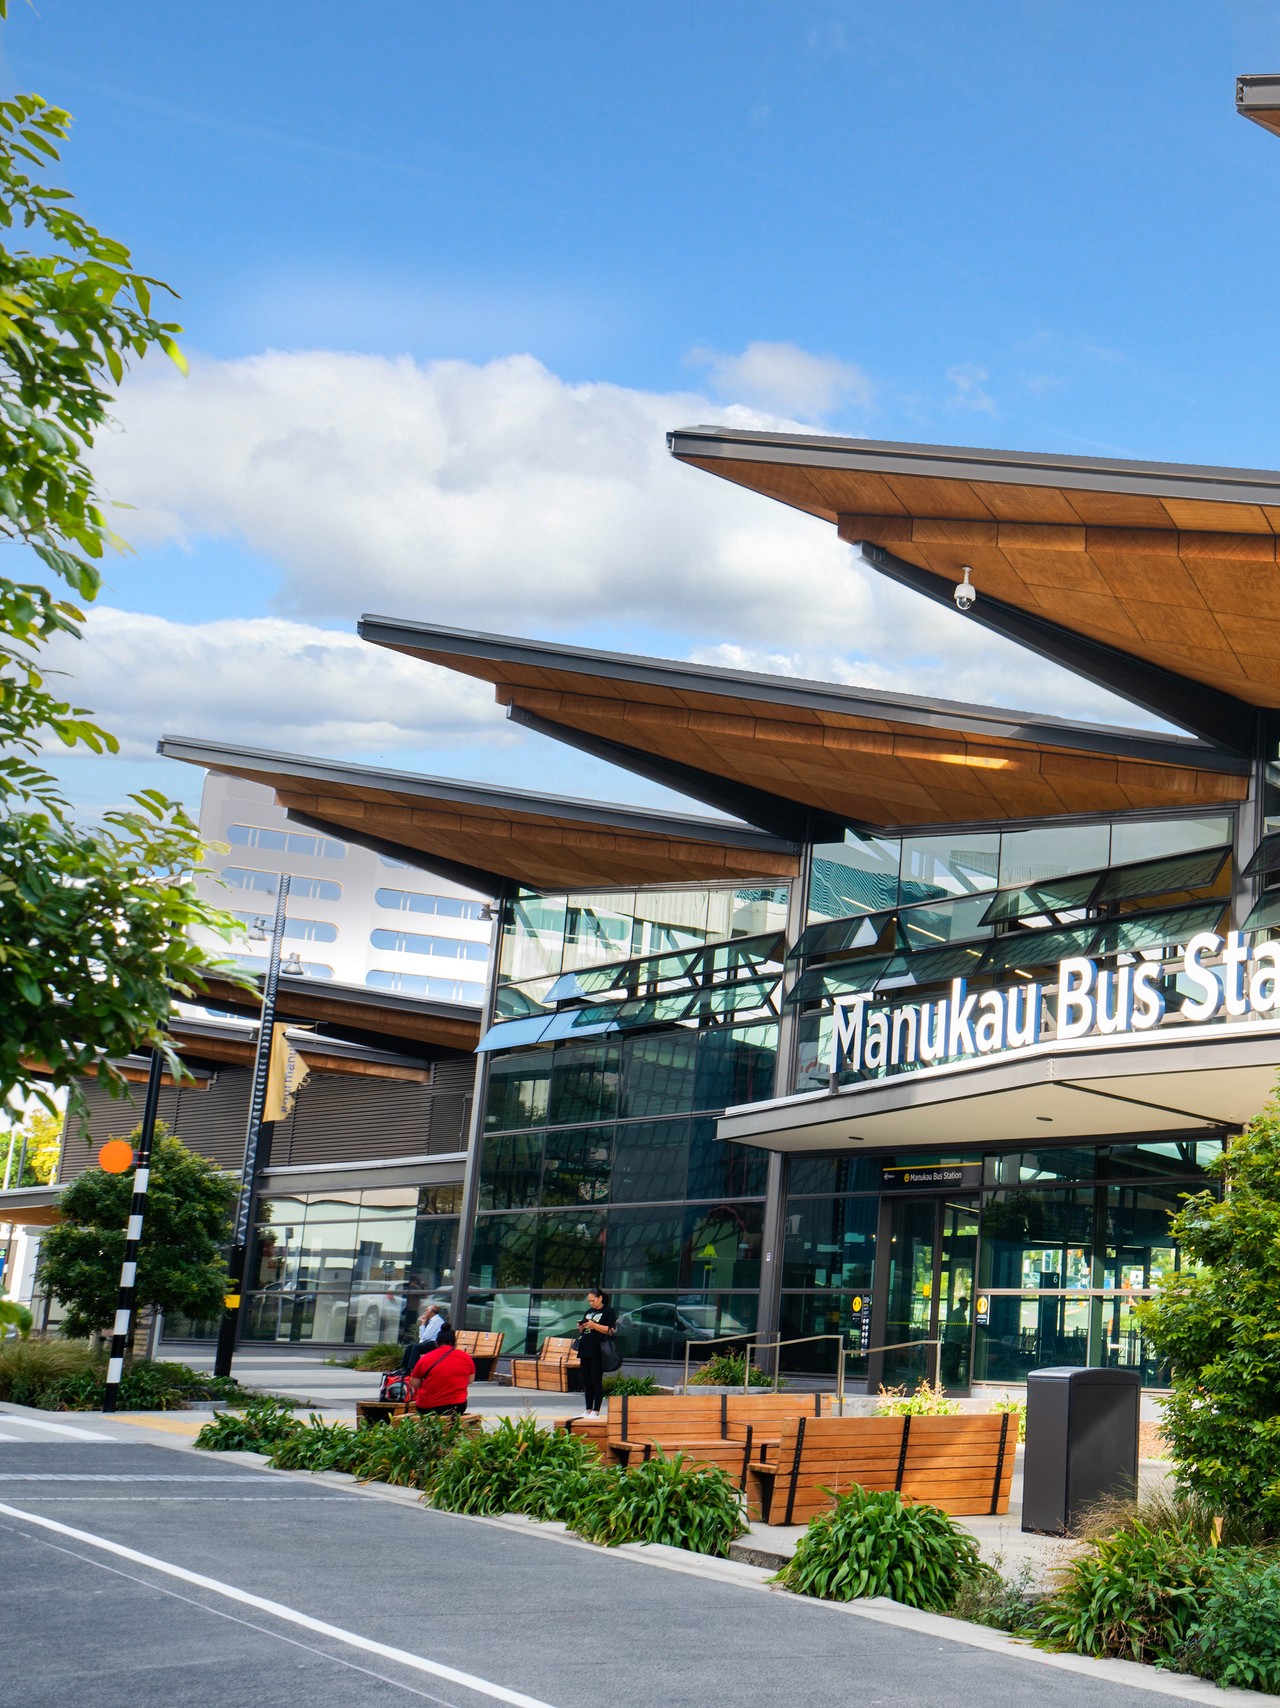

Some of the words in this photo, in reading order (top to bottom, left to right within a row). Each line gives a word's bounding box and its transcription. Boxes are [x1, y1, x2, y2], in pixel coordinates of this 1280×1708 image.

[829, 977, 1042, 1073] Manukau
[1057, 957, 1166, 1040] Bus
[909, 1173, 932, 1181] Manukau
[933, 1172, 943, 1180] Bus
[943, 1171, 962, 1180] Station
[1053, 1275, 1058, 1284] 6
